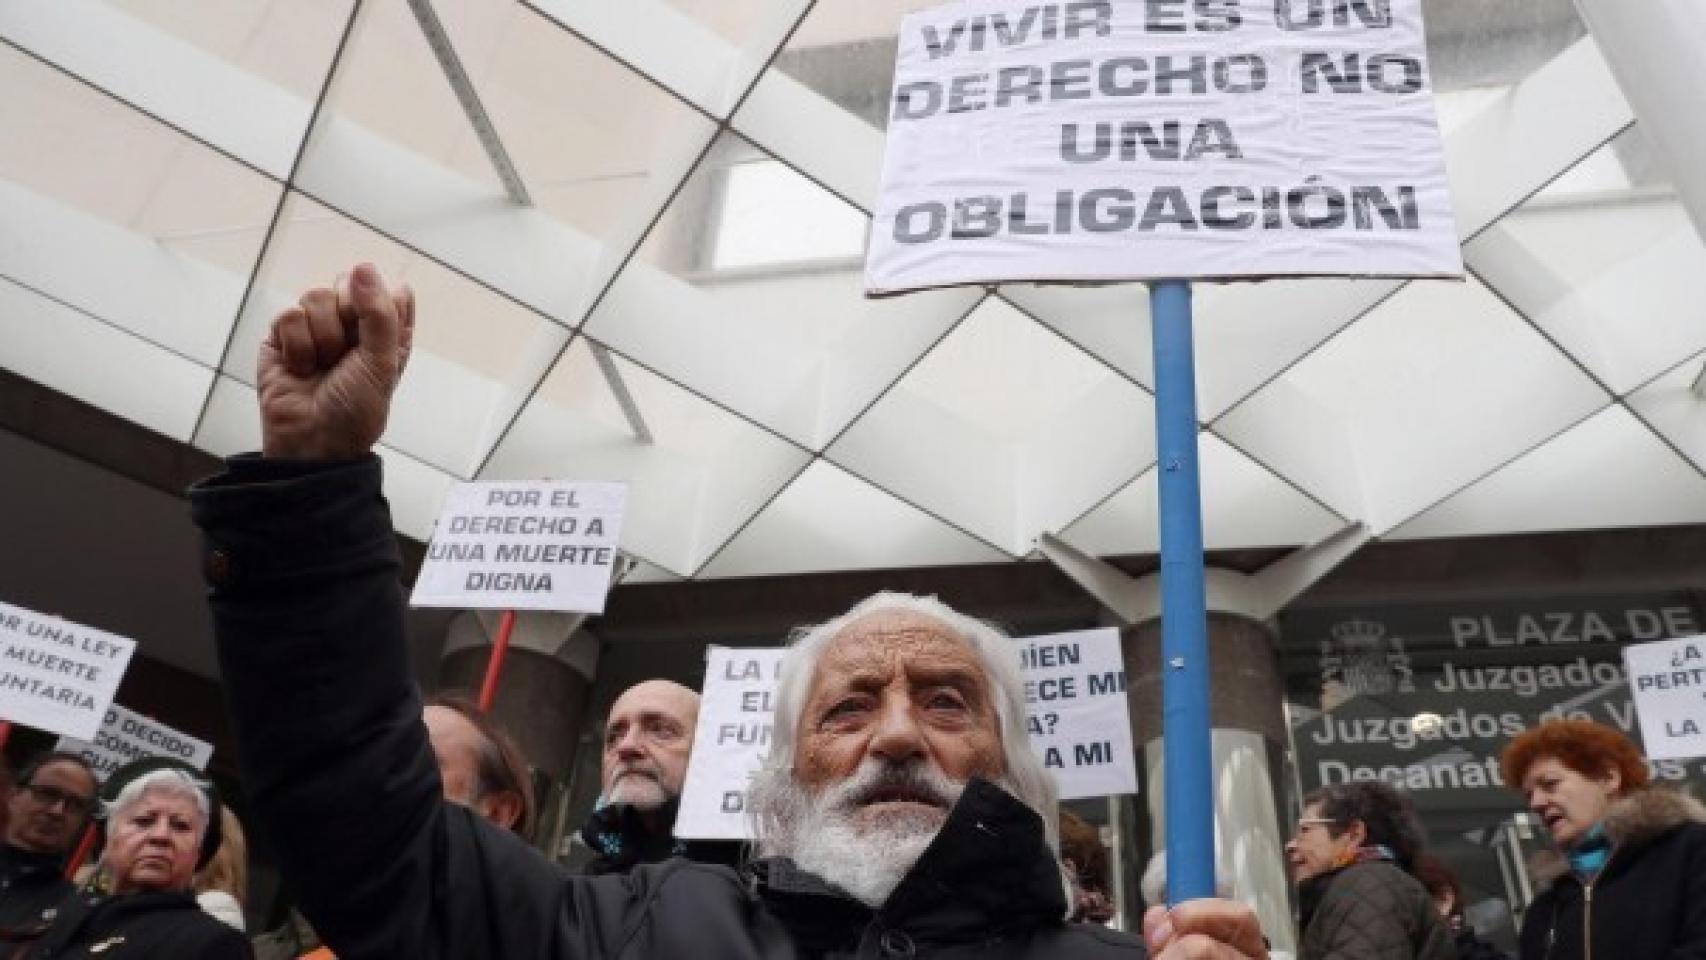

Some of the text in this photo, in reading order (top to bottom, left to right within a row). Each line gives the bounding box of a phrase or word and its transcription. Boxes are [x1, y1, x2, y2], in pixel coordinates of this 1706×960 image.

[922, 0, 1393, 60] VIVIR ES UN
[893, 51, 1424, 121] DERECHO NO
[1059, 118, 1244, 162] UNA
[892, 175, 1420, 244] OBLIGACIÓN
[486, 488, 581, 508] POR EL
[449, 516, 604, 537] DERECHO A
[429, 543, 611, 566] UNA MUERTE
[464, 572, 552, 592] DIGNA
[0, 612, 123, 659] R UNA LEY
[1451, 606, 1694, 648] PLAZA DE
[5, 646, 100, 681] MUERTE
[725, 660, 761, 682] LA
[1435, 658, 1626, 697] Juzgado
[1087, 671, 1128, 696] MI
[121, 719, 195, 757] DECIDO
[1313, 709, 1527, 751] Juzgados
[1665, 718, 1702, 738] LA
[1074, 741, 1115, 767] MI
